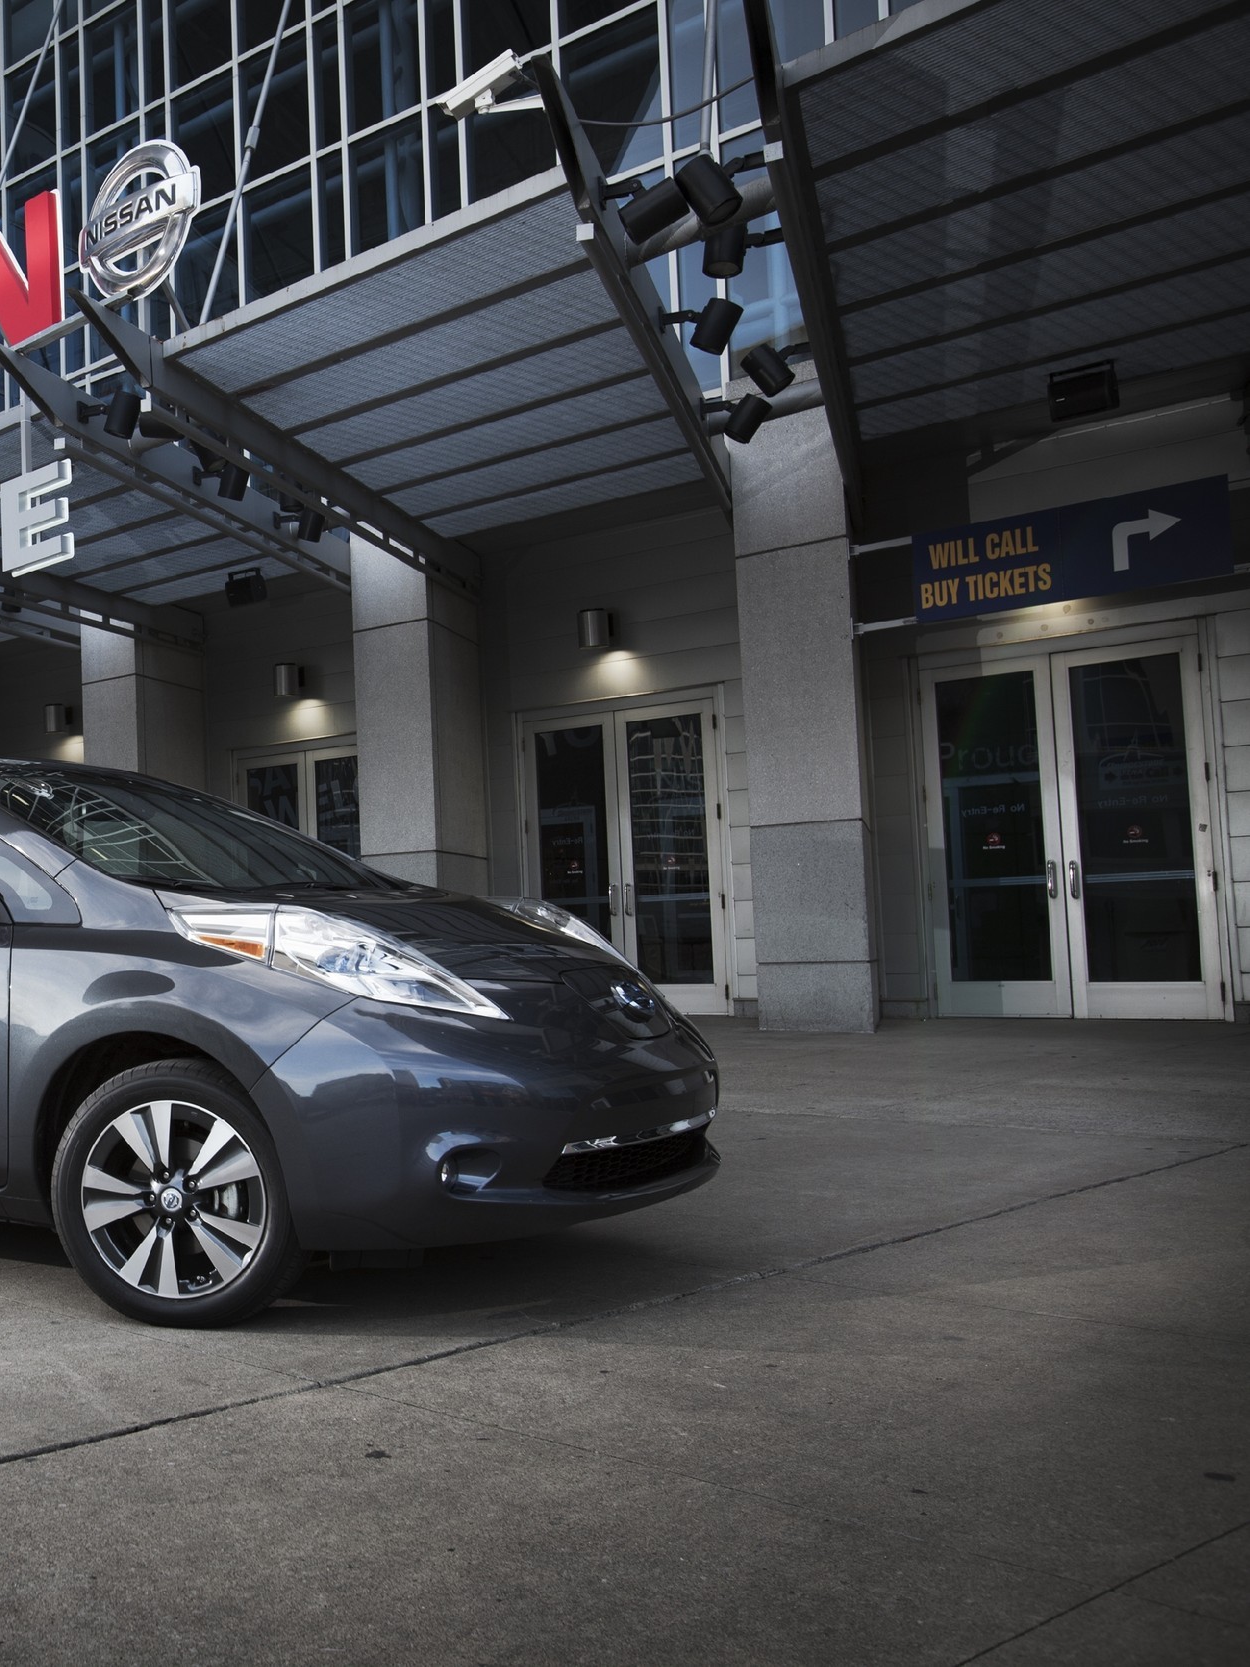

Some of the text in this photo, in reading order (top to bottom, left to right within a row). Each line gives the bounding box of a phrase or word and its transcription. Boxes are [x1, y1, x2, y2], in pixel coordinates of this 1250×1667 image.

[86, 183, 176, 251] NISSAN
[928, 526, 1039, 570] WILL CALL
[920, 562, 1052, 610] BUY TICKETS
